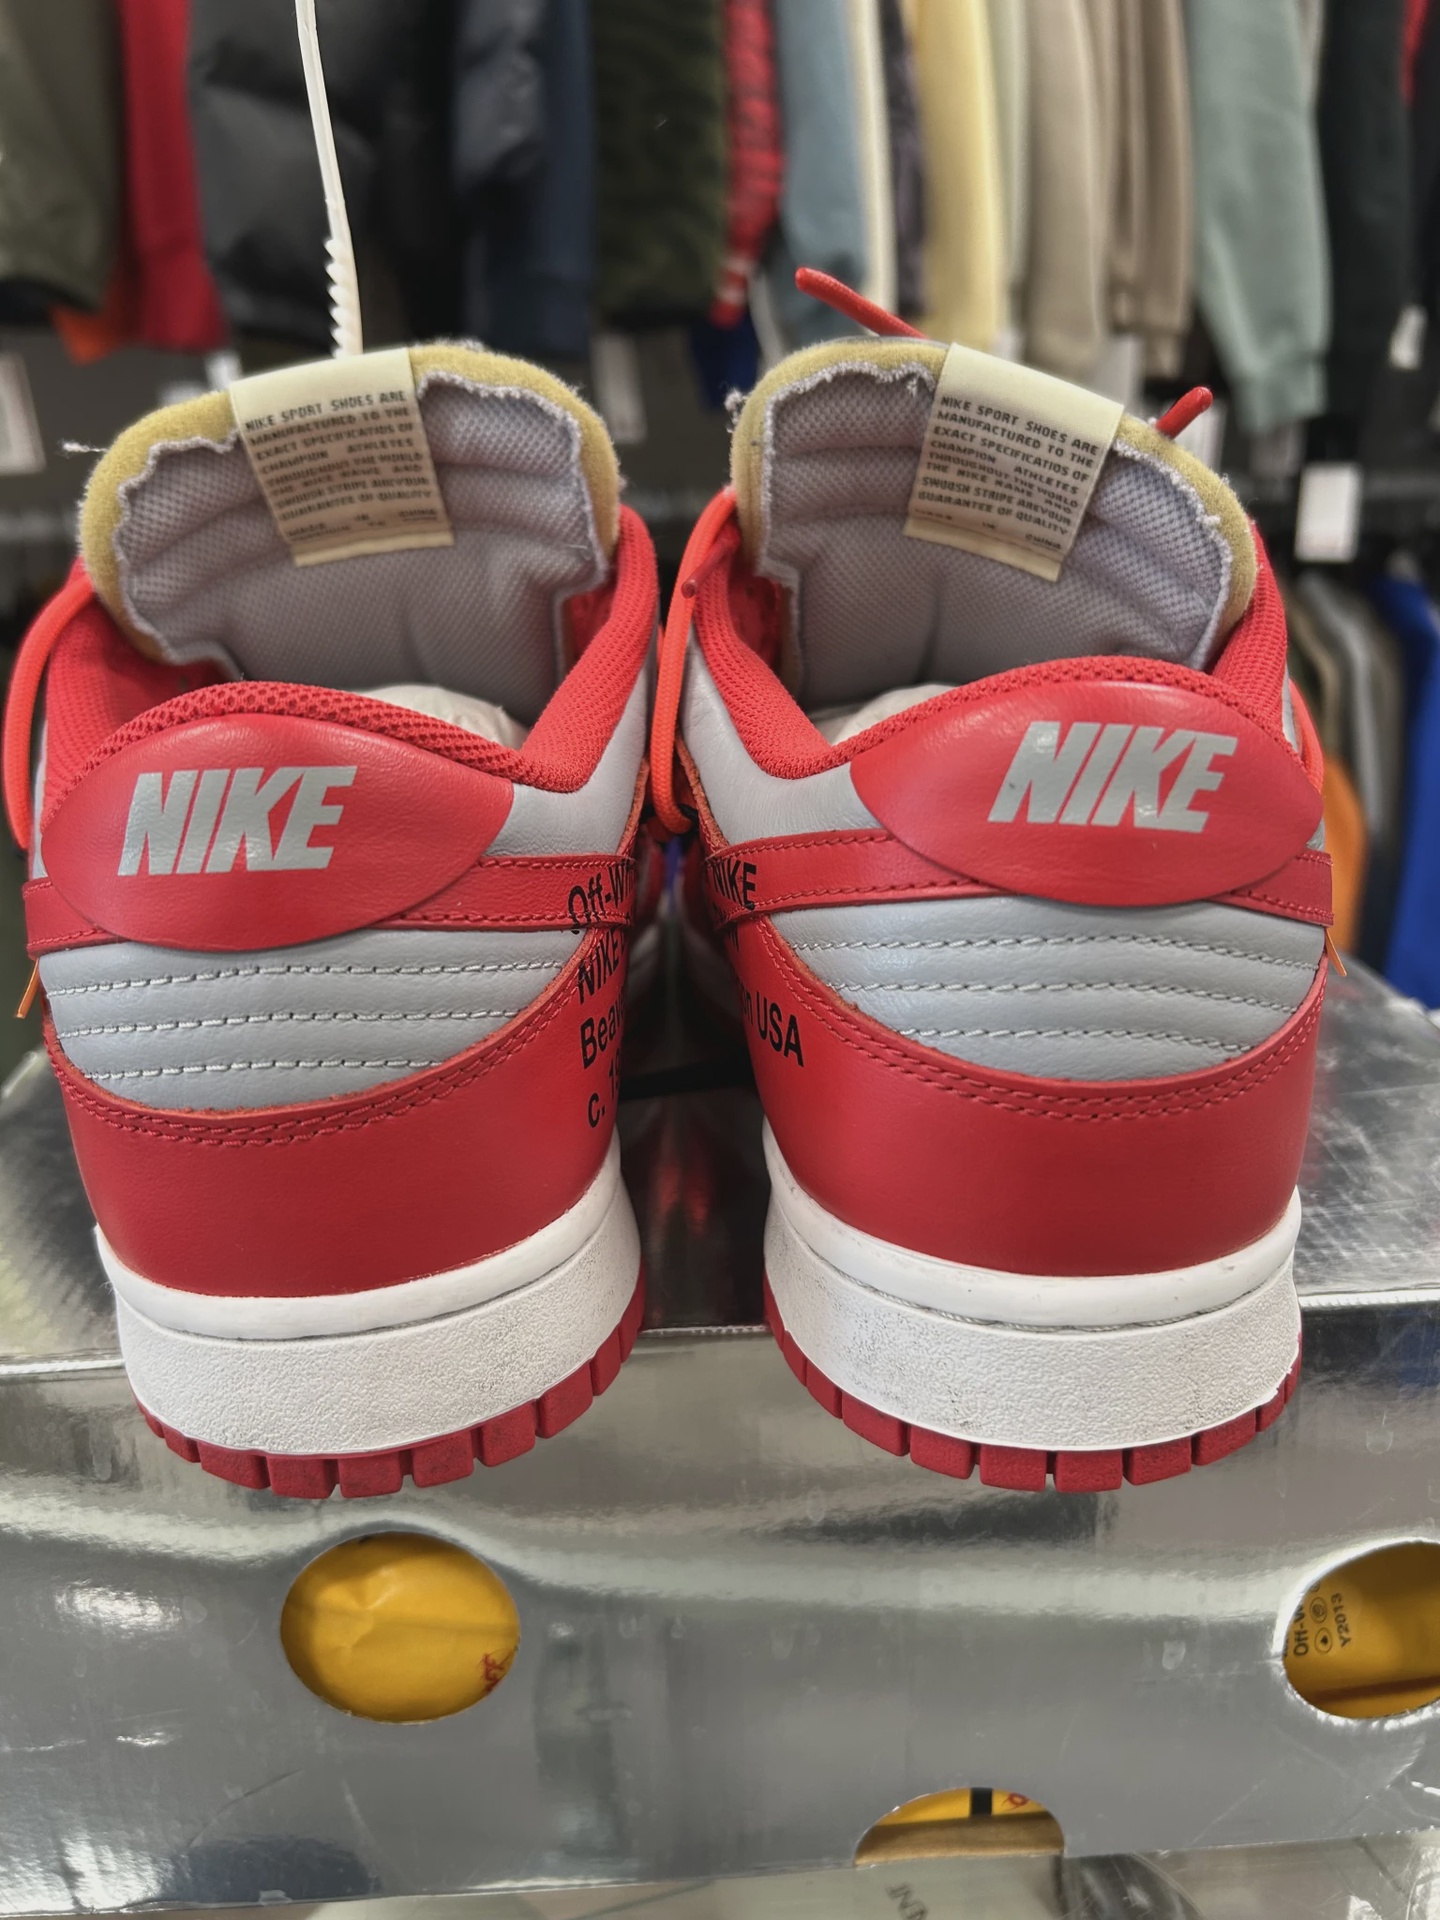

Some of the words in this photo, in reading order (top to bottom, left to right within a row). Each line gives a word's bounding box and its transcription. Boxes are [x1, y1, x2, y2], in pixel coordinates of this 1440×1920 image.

[244, 414, 275, 432] NIKE
[280, 403, 322, 422] SPORT
[330, 394, 374, 411] SHOES
[379, 390, 406, 404] ARE
[361, 410, 381, 422] TO
[384, 406, 410, 418] THE
[937, 410, 1041, 450] MANUFACTURED
[1048, 444, 1064, 458] TO
[1070, 452, 1094, 468] THE
[940, 395, 972, 412] NIKE
[976, 404, 1020, 426] SPORT
[1025, 420, 1068, 444] SHOES
[1070, 438, 1100, 456] ARE
[929, 451, 1010, 479] THROUGHOUT
[1014, 476, 1035, 490] THE
[1037, 486, 1079, 508] WORLD
[930, 440, 997, 464] CHAMPION
[1013, 466, 1079, 495] ATHLETES
[933, 425, 976, 443] EXACT
[1072, 470, 1090, 482] OF
[918, 491, 993, 513] GUARANTEE
[997, 507, 1013, 516] OF
[1015, 511, 1068, 536] QUALITY
[922, 476, 971, 494] SWOOSH
[974, 487, 1014, 504] STRIPE
[926, 461, 949, 473] THE
[956, 469, 988, 483] NIKE
[994, 479, 1033, 498] NAME
[1044, 499, 1073, 514] AND
[988, 721, 1238, 833] NIKE
[117, 766, 357, 876] NIKE
[710, 857, 757, 911] NIKE
[578, 927, 620, 1004] NIKE
[580, 997, 624, 1069] Beav
[756, 991, 804, 1067] USA
[588, 1092, 606, 1128] c.
[1331, 1592, 1352, 1648] Y2013
